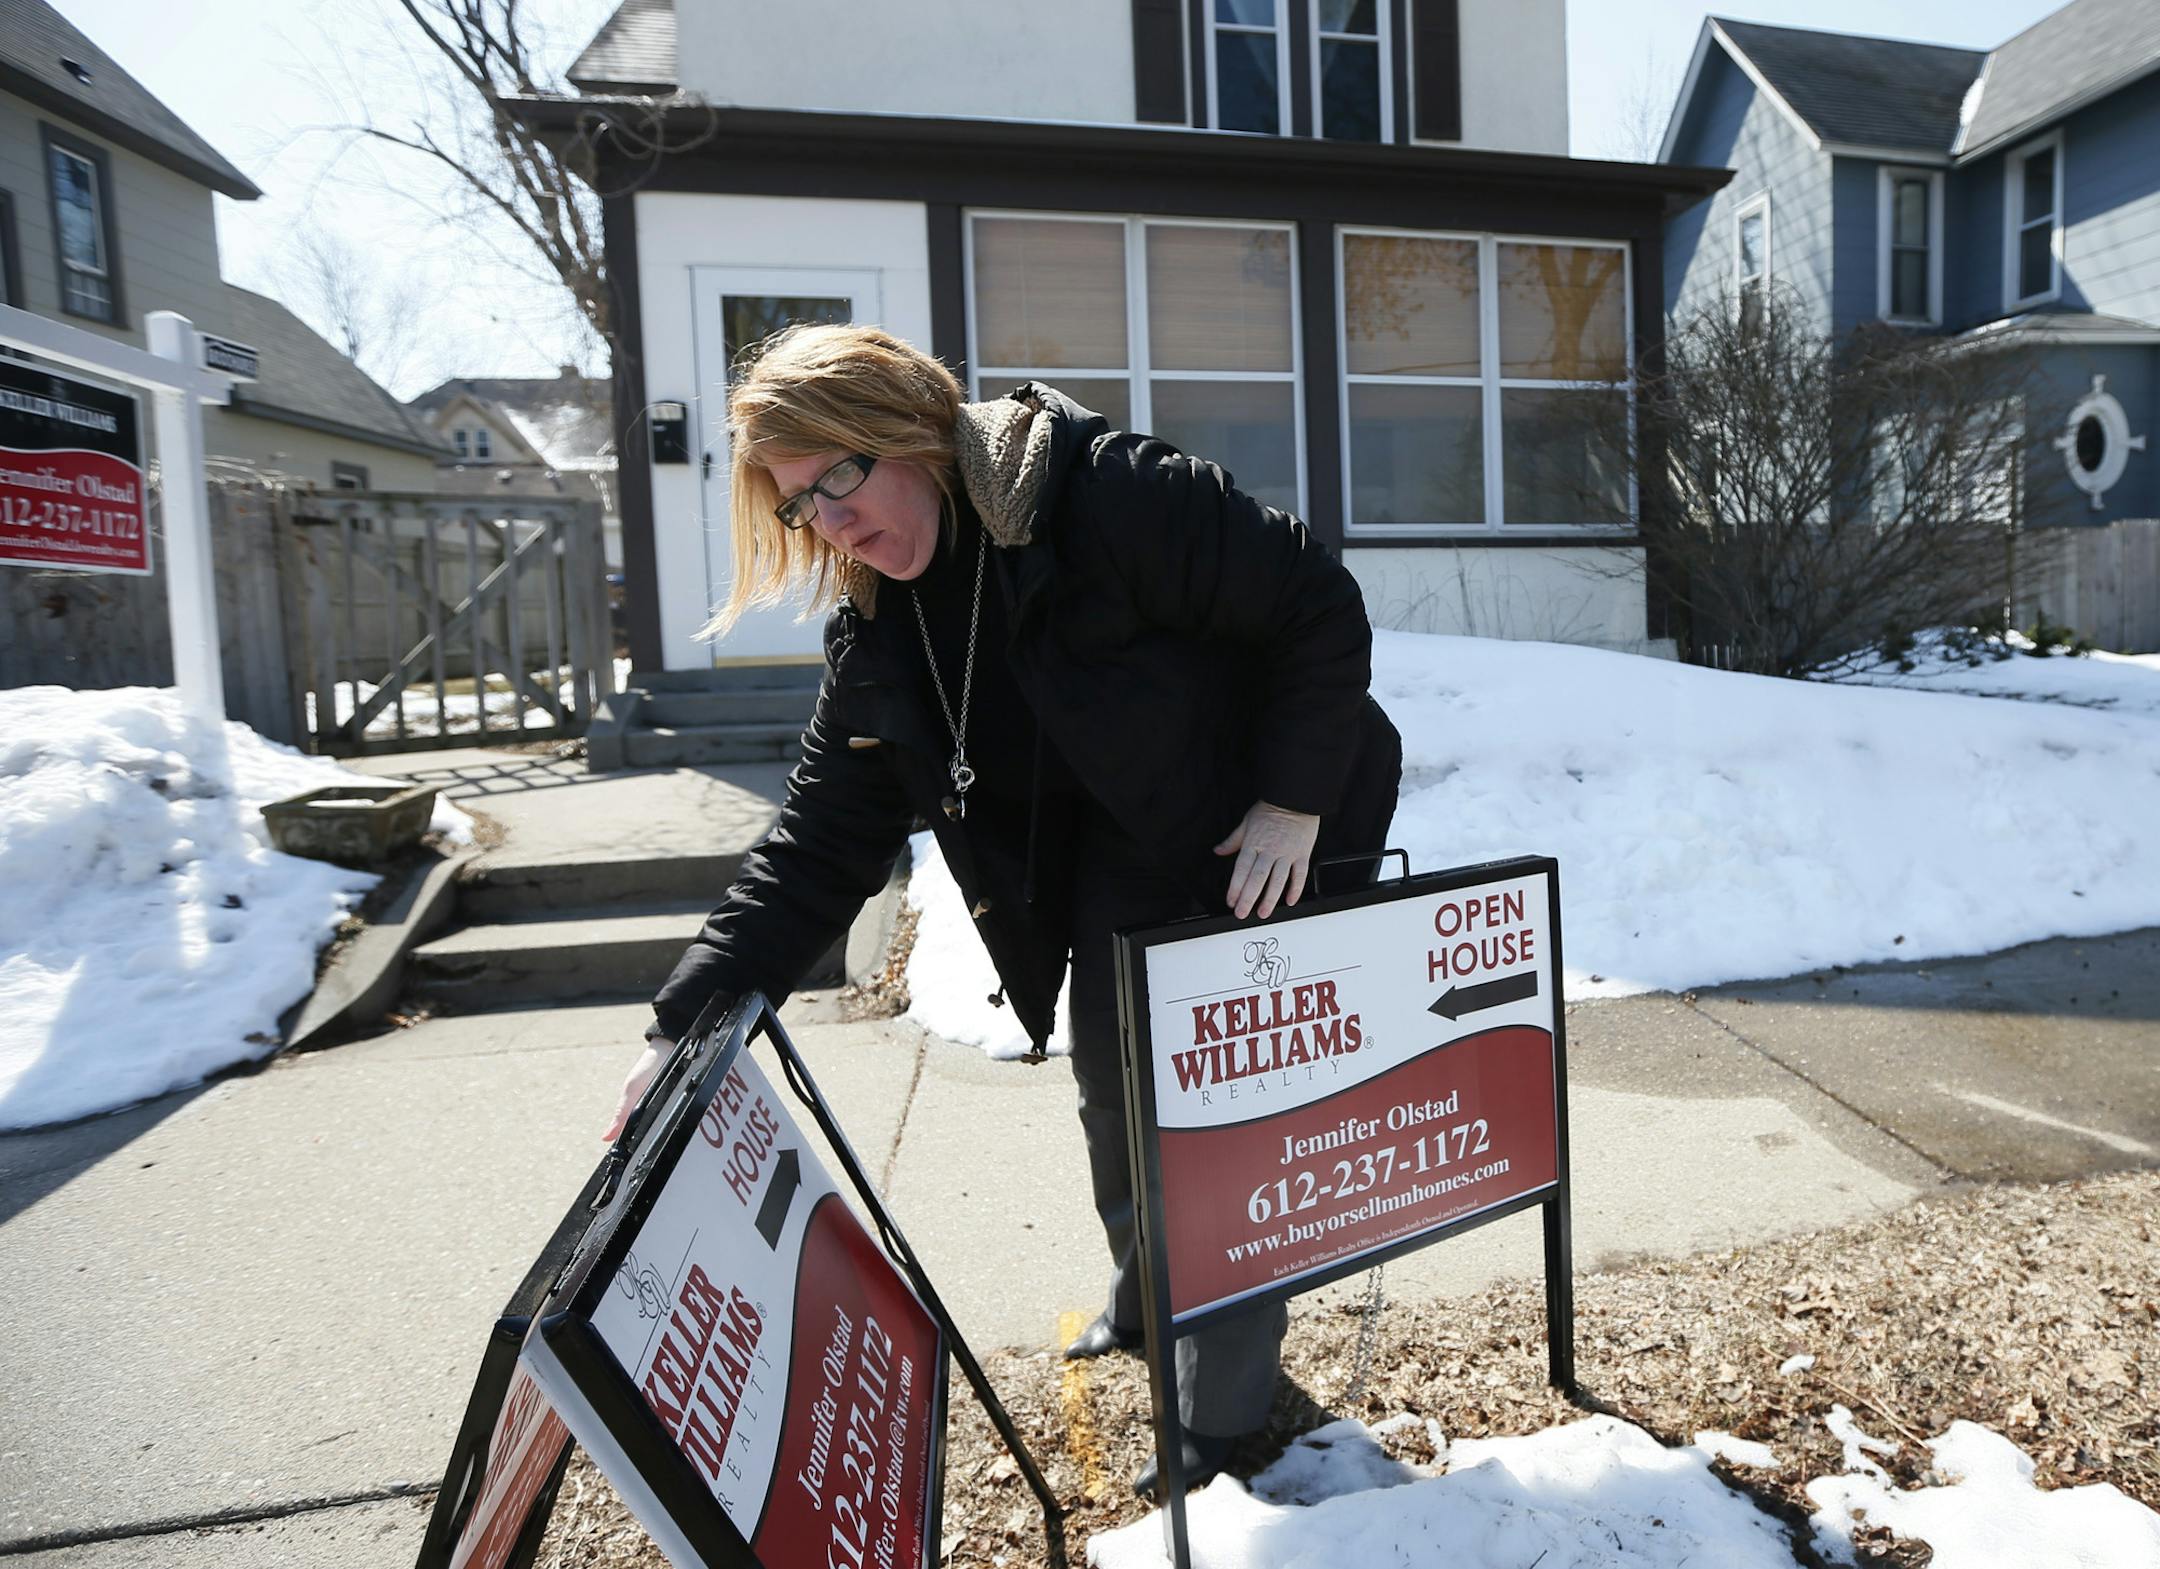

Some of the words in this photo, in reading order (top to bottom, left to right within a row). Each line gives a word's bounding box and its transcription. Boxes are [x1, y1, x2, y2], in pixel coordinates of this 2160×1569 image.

[0, 466, 74, 494] ennifer
[76, 473, 136, 504] Olstad
[0, 496, 139, 539] 12-237-1172
[1434, 889, 1524, 938] OPEN
[1428, 929, 1534, 983] HOUSE
[1171, 1013, 1363, 1093] WILLIAMS
[1192, 980, 1341, 1046] KELLER
[699, 1065, 750, 1149] OPEN
[1201, 1059, 1341, 1106] REALTY
[722, 1095, 780, 1207] HOUSE
[1280, 1117, 1381, 1166] Jennifer
[1387, 1090, 1460, 1131] Olstad
[1226, 1157, 1511, 1263] www.buyorsellmnhomes.com
[1248, 1118, 1490, 1224] 612-237-1172
[716, 1350, 772, 1516] REALTY
[797, 1385, 838, 1511] Jennifer
[822, 1304, 853, 1388] Olstad
[874, 1354, 914, 1569] ifer.Olstad@kw.com
